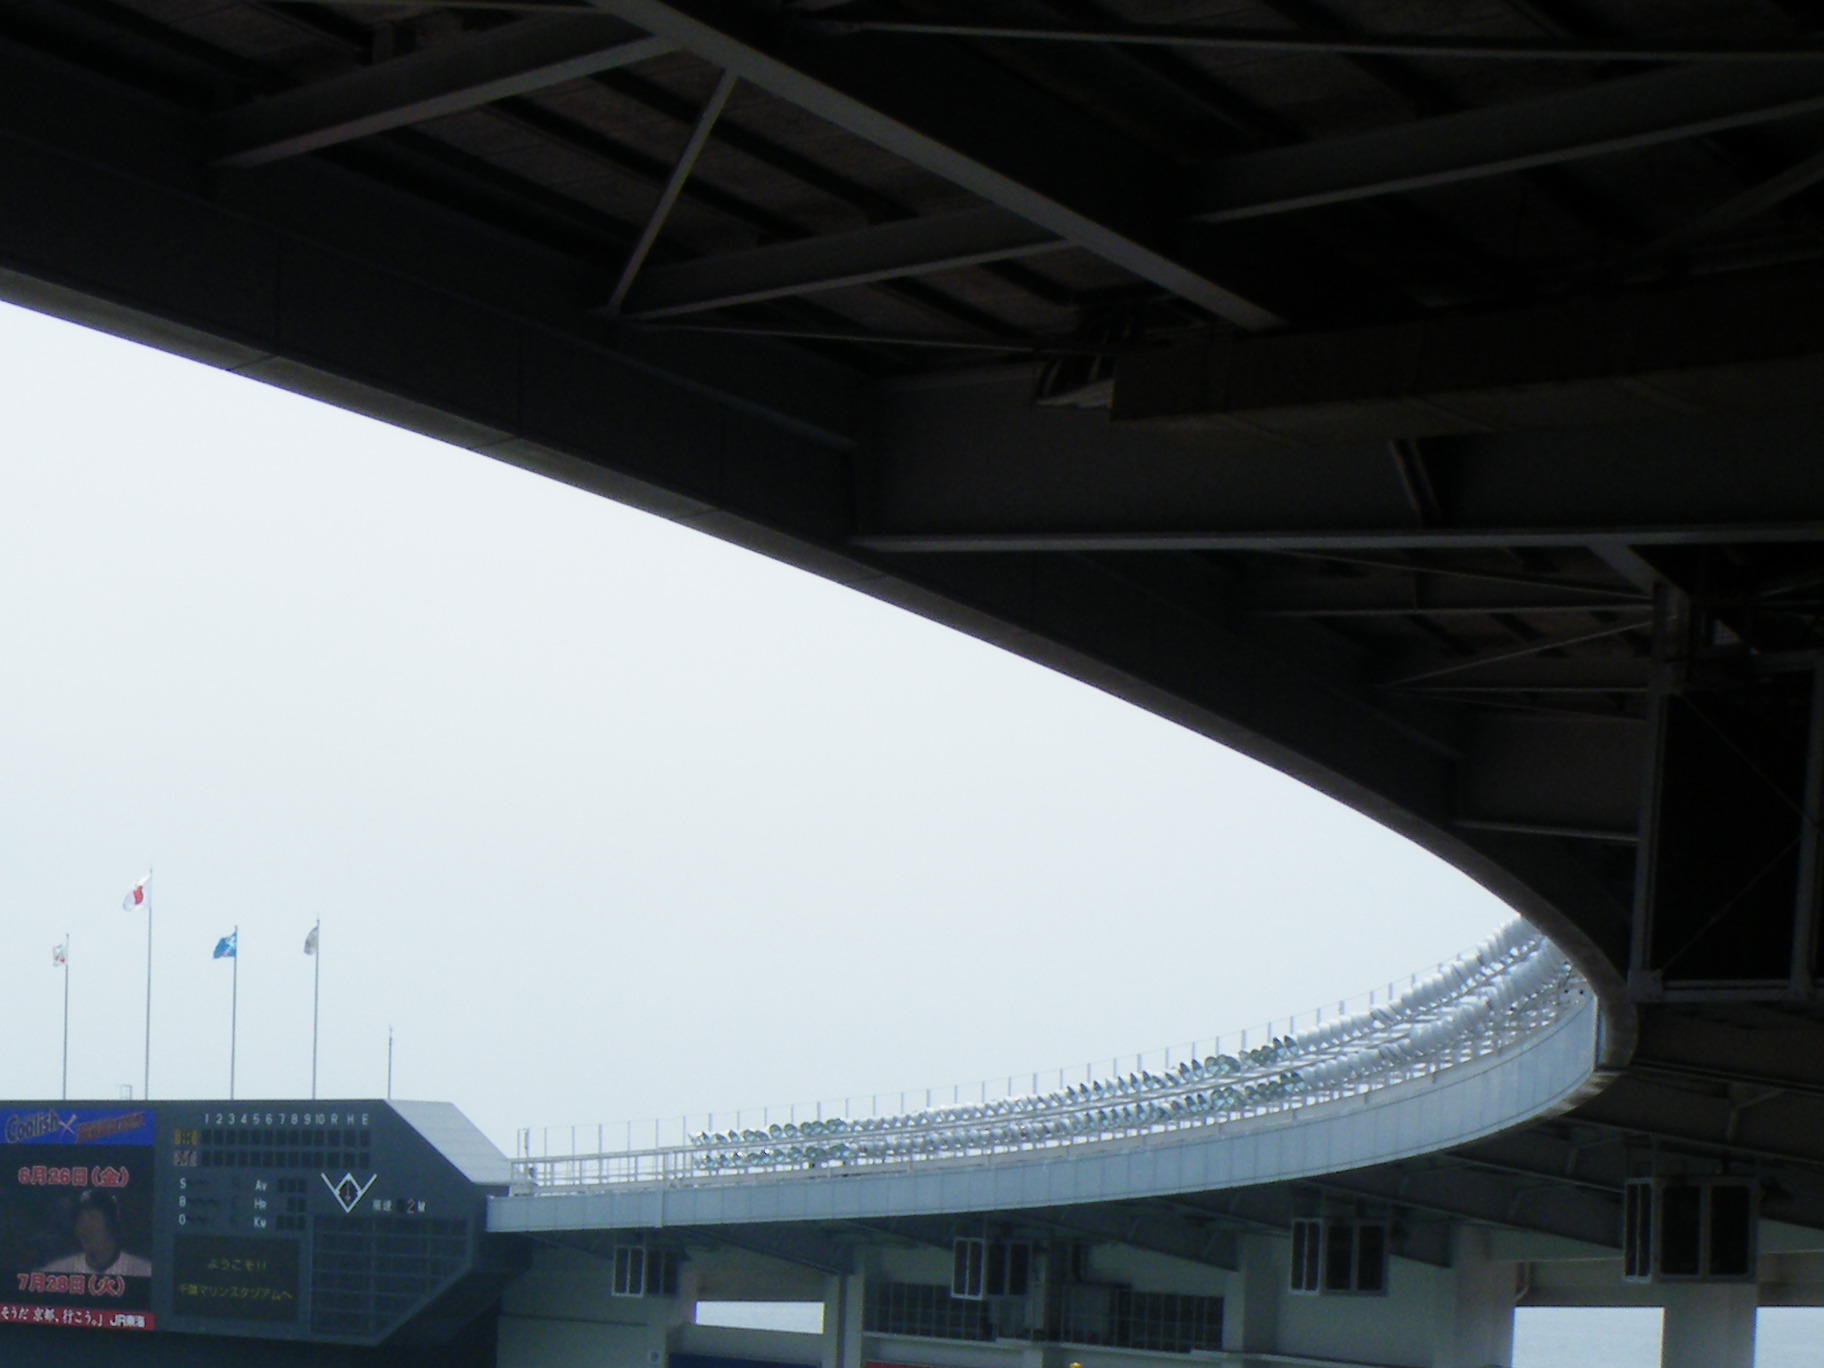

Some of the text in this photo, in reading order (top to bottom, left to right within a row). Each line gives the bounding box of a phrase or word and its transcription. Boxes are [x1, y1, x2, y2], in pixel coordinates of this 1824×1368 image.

[204, 1113, 369, 1126] 1 2 3 4 5 6 7 8 9 10 R H E
[5, 1110, 59, 1144] Coolish
[179, 1177, 187, 1190] S
[109, 1314, 146, 1329] JR東海
